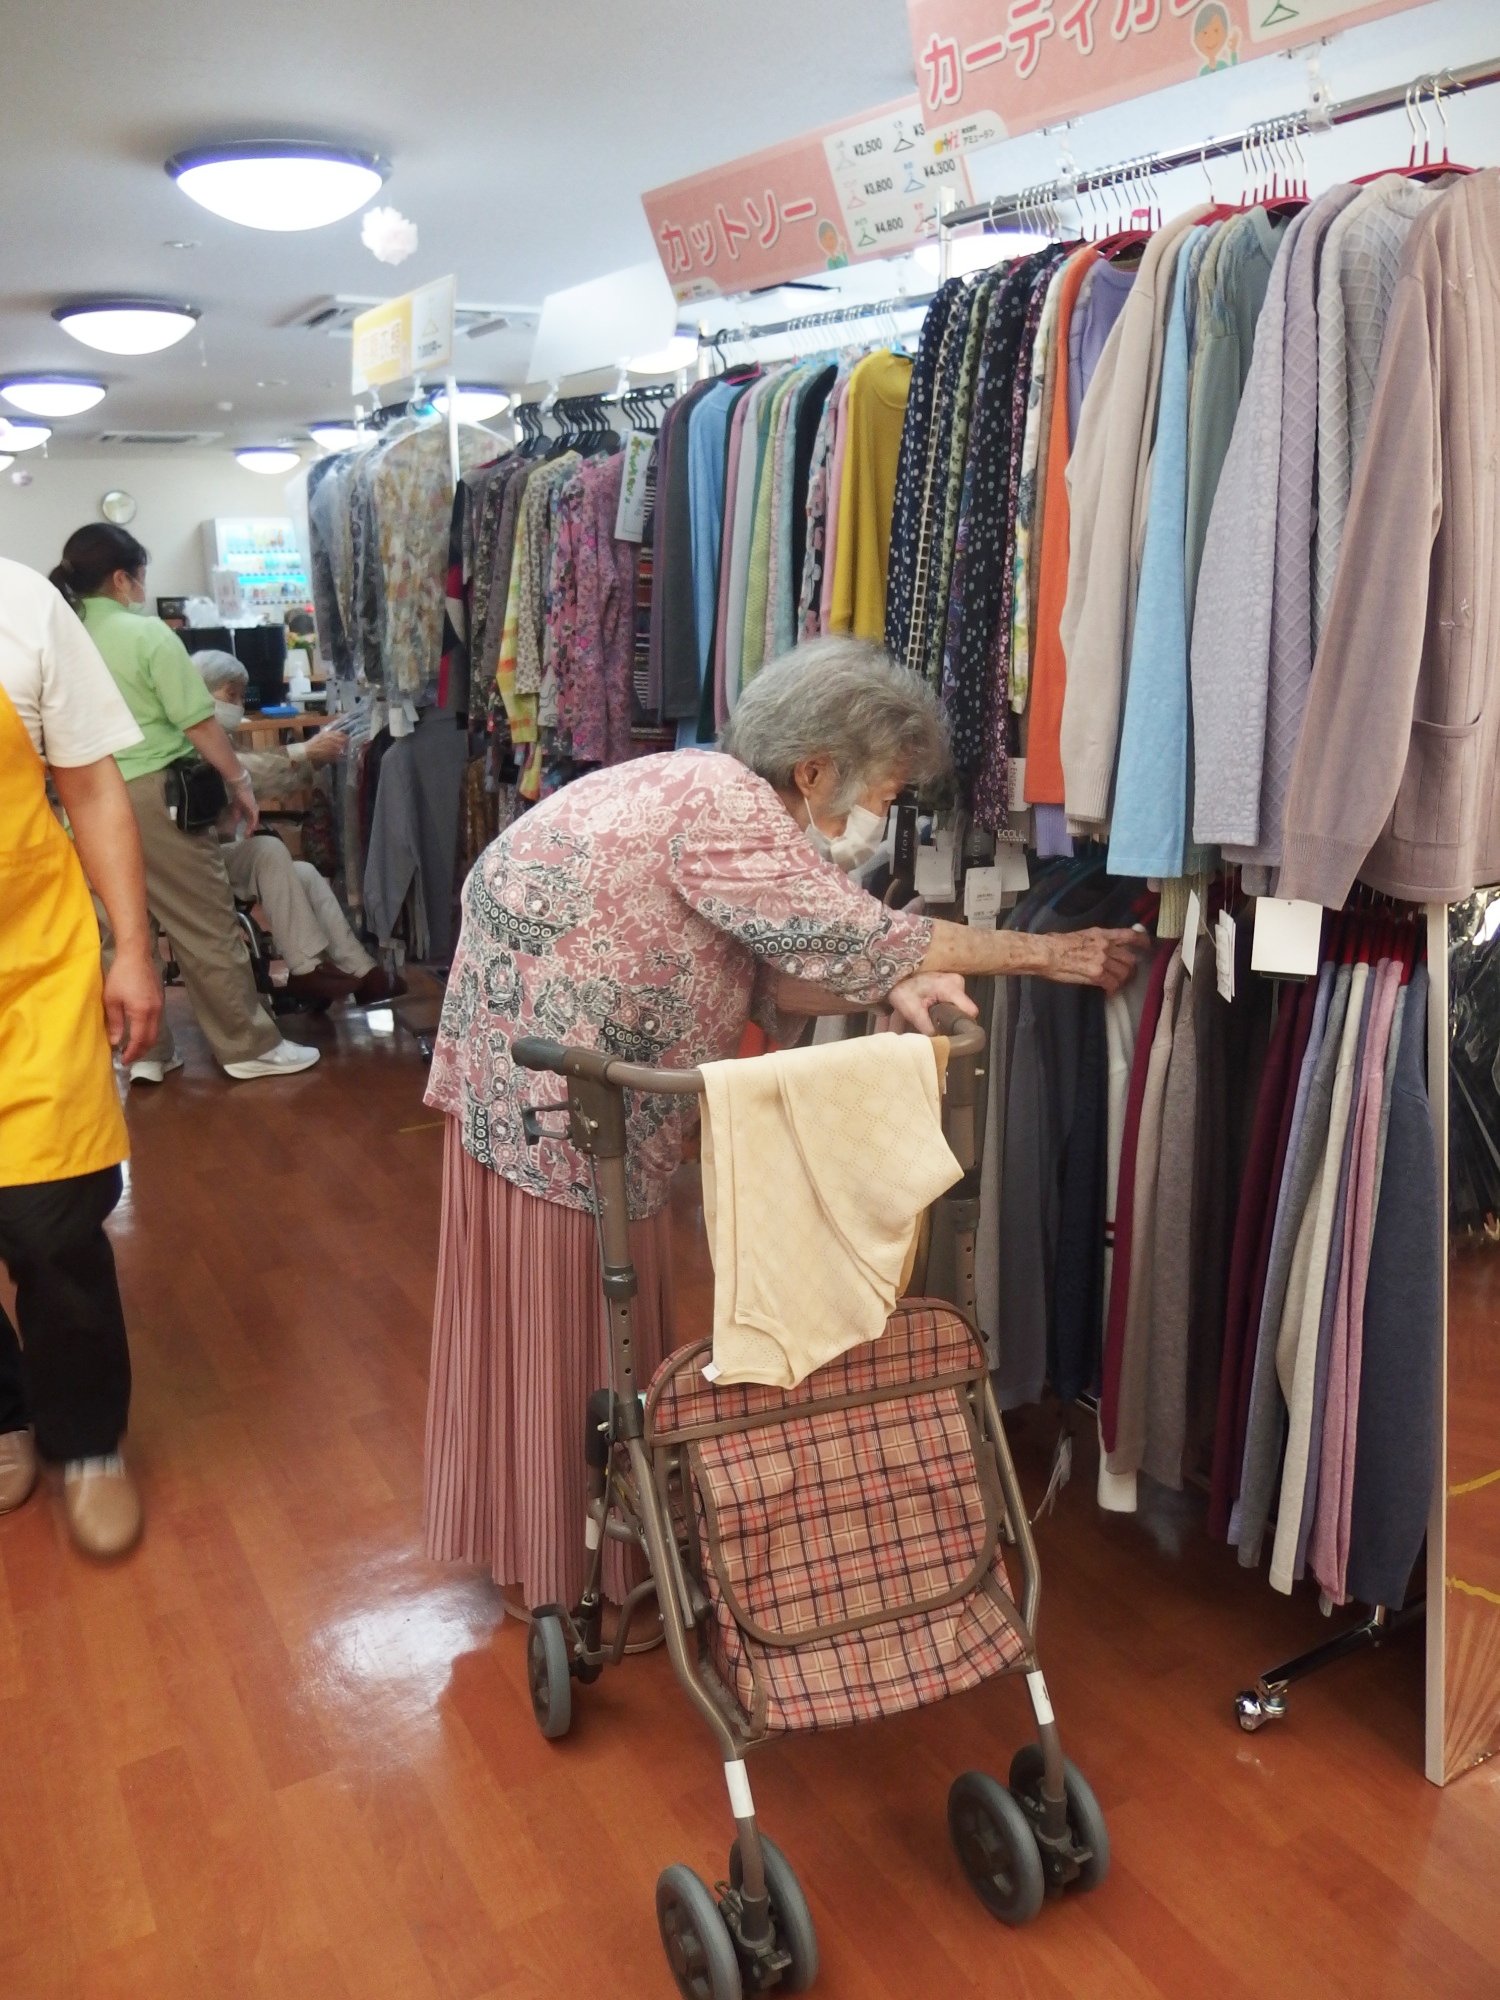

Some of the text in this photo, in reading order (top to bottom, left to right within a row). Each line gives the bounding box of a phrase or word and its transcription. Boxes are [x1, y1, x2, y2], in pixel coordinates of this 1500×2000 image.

[661, 190, 816, 274] カットソー
